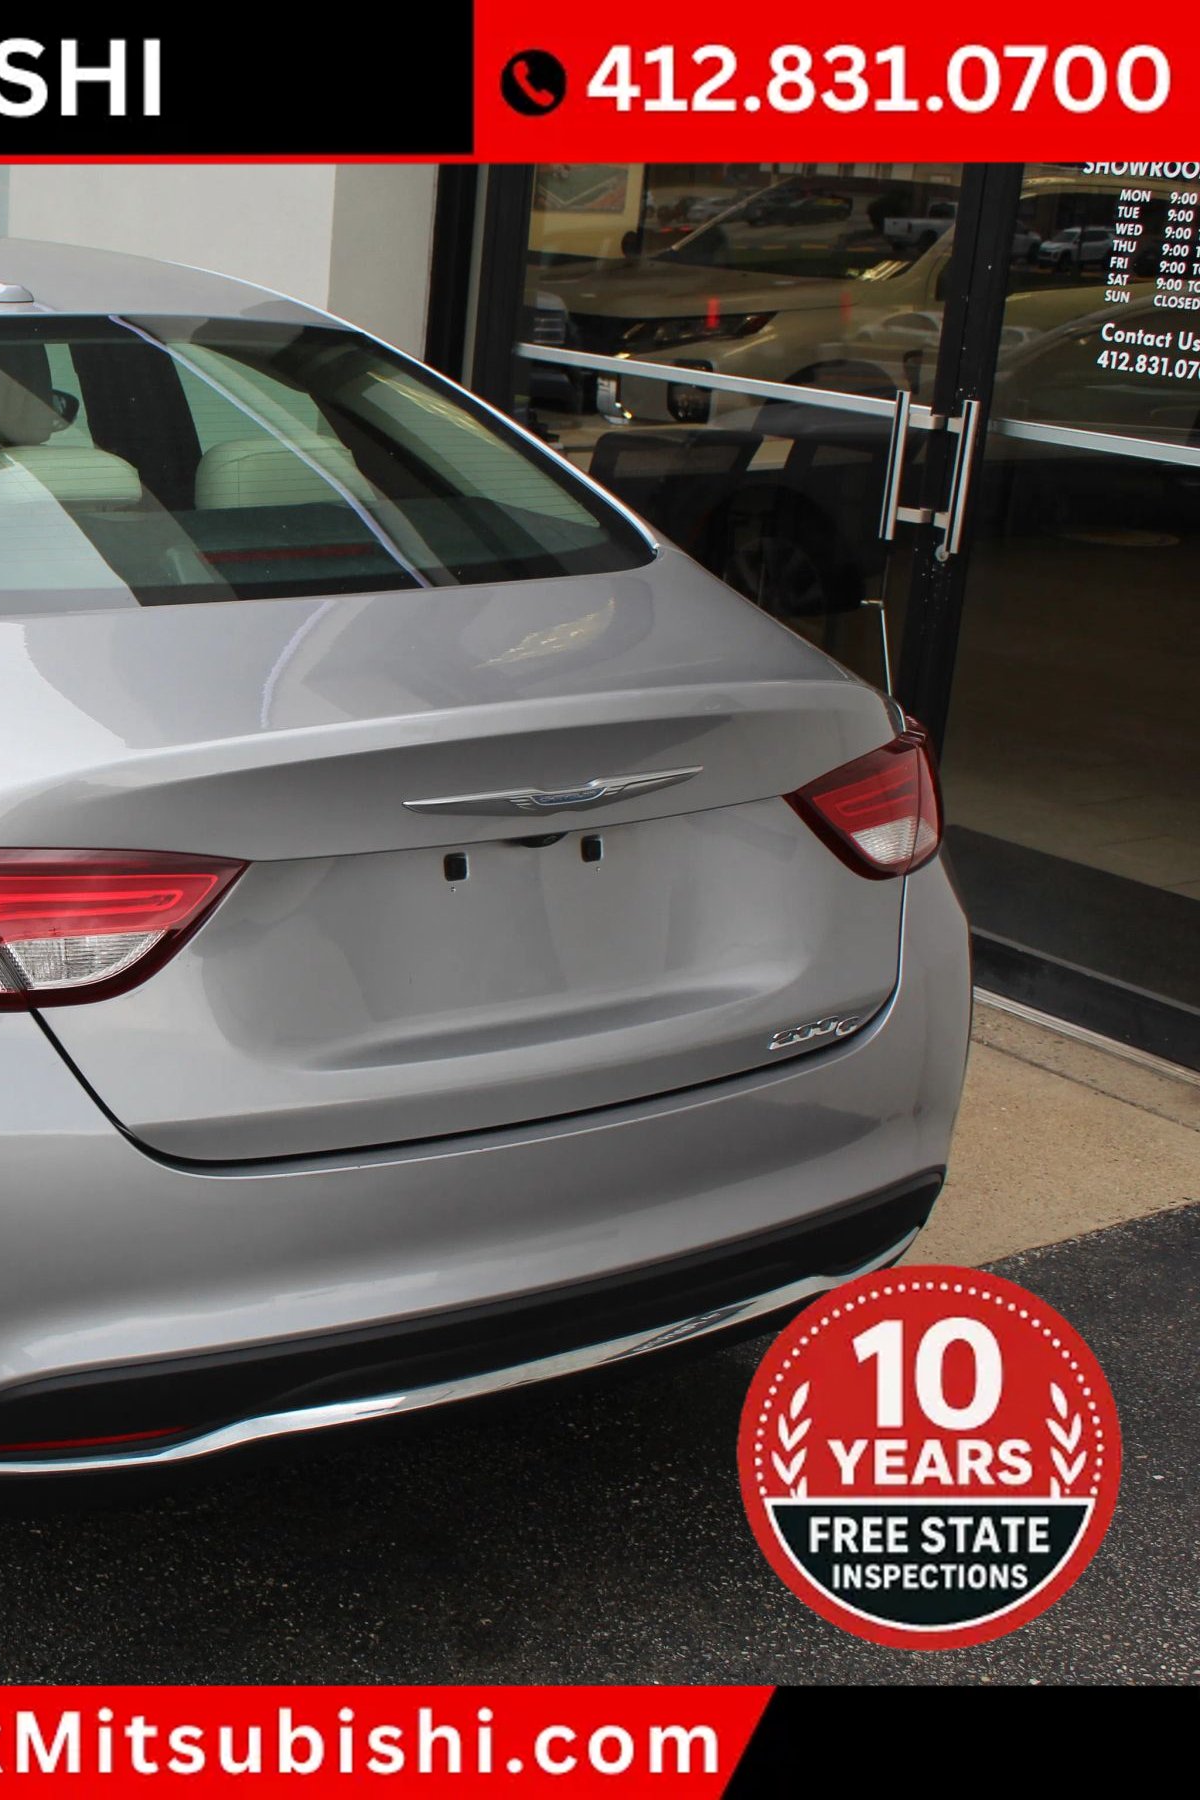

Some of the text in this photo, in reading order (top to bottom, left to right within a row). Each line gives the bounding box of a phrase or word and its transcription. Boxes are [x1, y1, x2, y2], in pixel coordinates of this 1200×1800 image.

[1082, 162, 1200, 179] SHOWROO
[1120, 189, 1198, 205] MON 9:00
[1118, 206, 1194, 222] TUE 9:00
[1115, 223, 1192, 240] WED 9:00
[1112, 240, 1137, 253] THU
[1161, 244, 1189, 257] 9:00
[1109, 257, 1129, 269] FRI
[1159, 261, 1186, 275] 9:00
[1107, 274, 1130, 286] SAT
[1156, 278, 1183, 292] 9:00
[1104, 291, 1200, 311] SUN CLOSED
[1101, 323, 1200, 351] Contact Us
